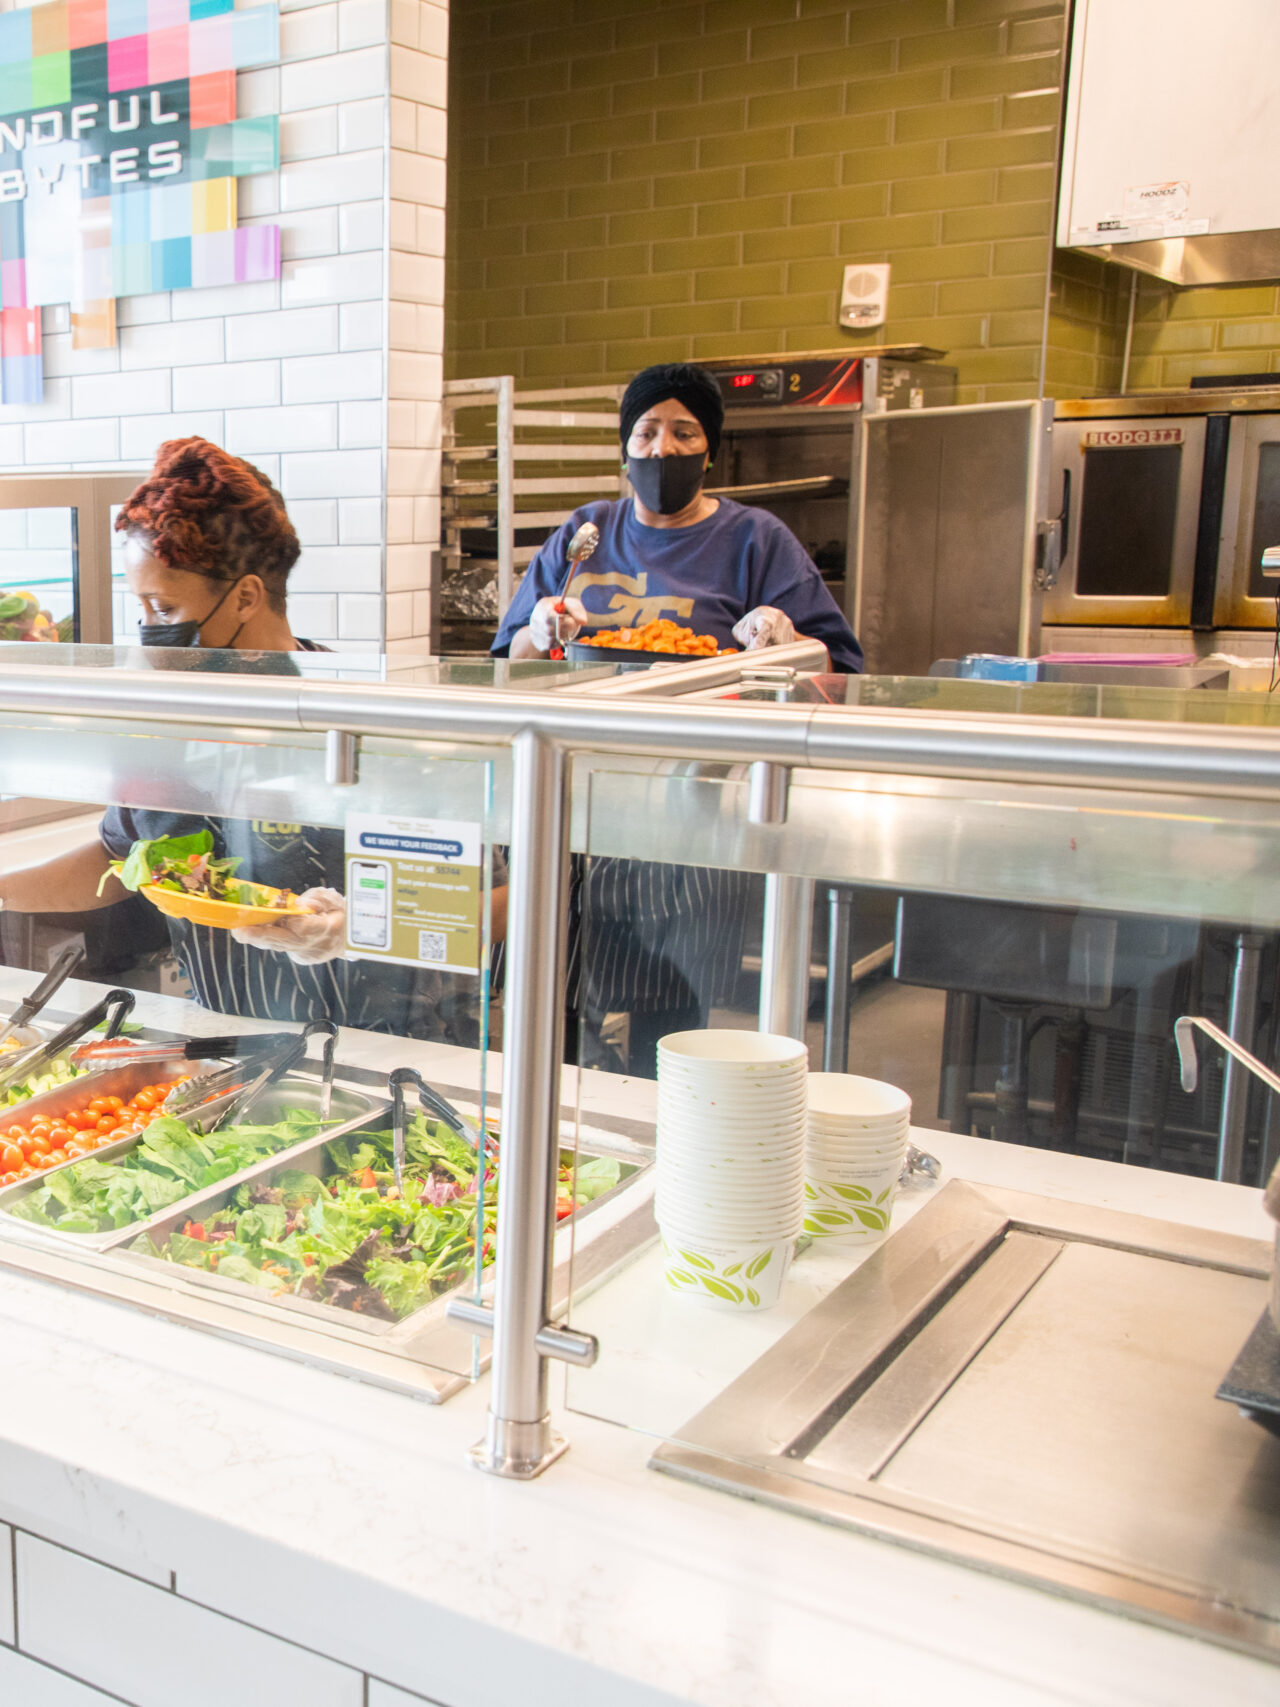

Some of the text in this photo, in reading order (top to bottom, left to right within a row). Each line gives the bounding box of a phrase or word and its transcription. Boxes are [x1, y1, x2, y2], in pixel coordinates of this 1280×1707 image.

[789, 373, 801, 392] 2
[1088, 430, 1179, 445] BLODGETT
[363, 835, 459, 853] WE WANT YOUR FEEDBACK
[396, 861, 413, 871] Text
